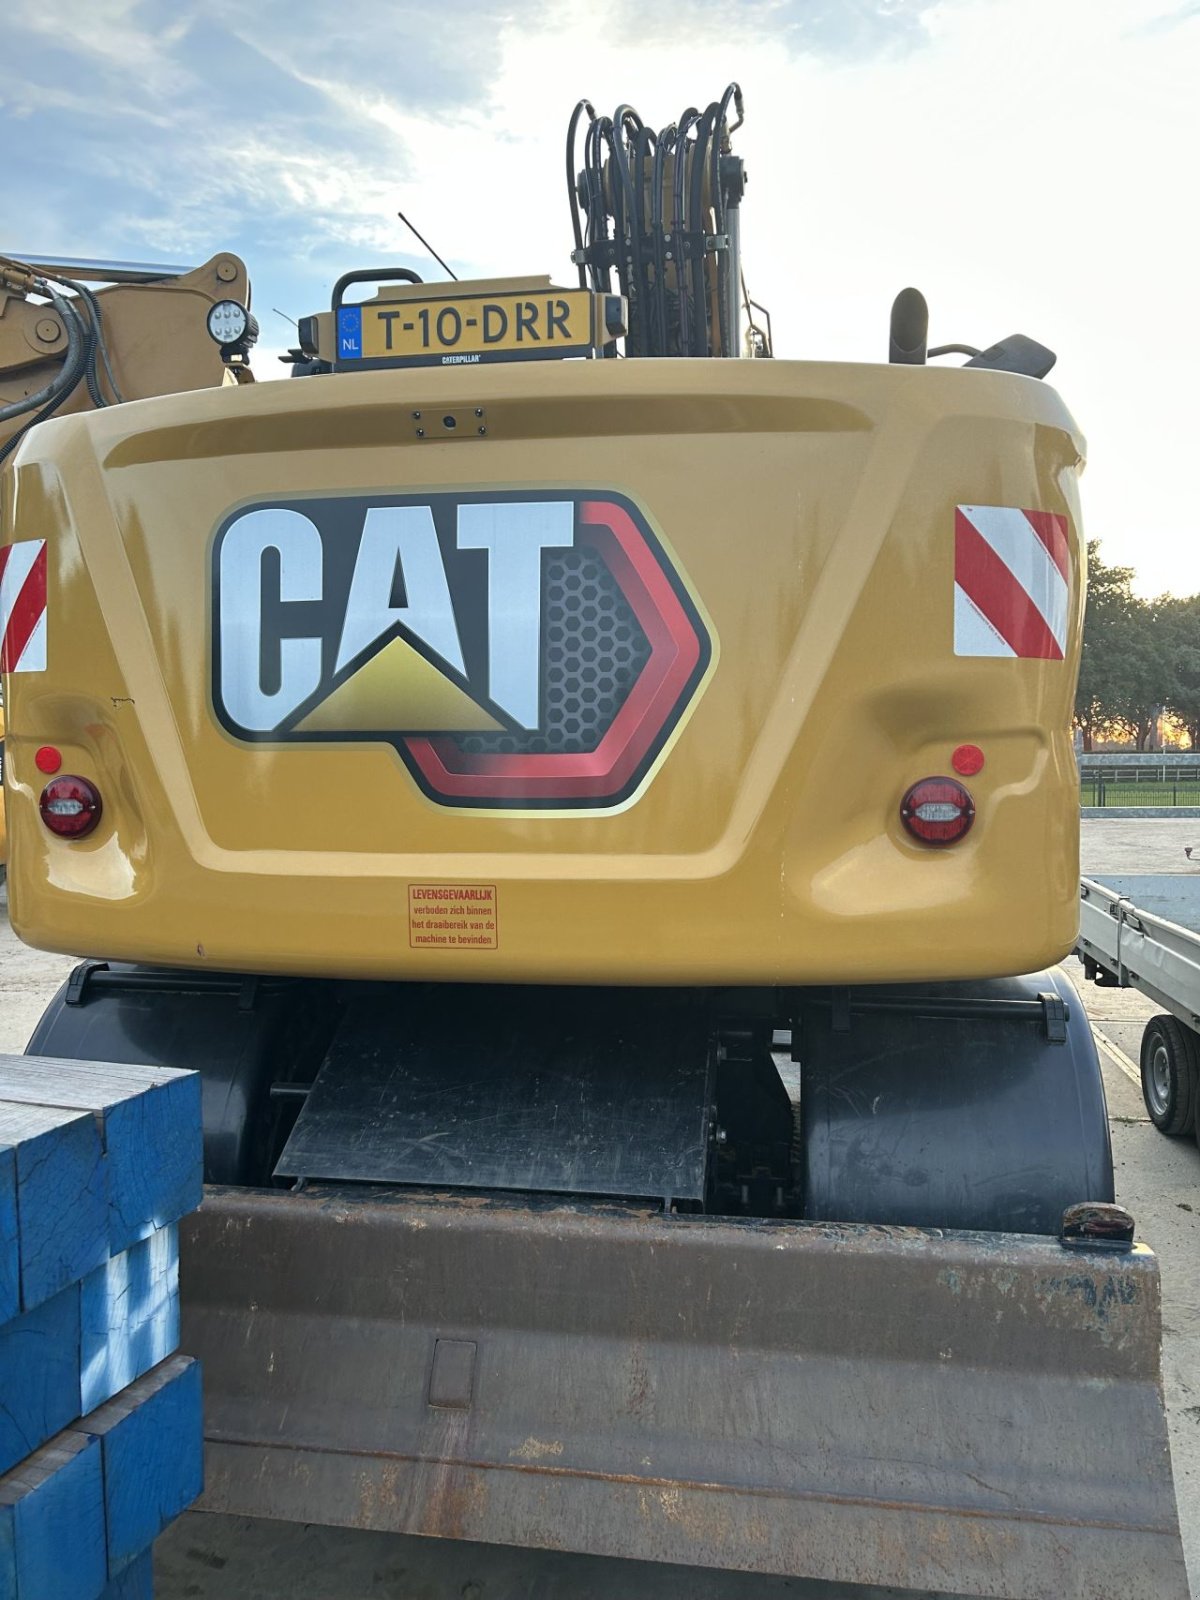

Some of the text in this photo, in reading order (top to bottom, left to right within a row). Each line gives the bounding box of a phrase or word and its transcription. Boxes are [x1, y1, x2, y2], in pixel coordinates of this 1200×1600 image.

[377, 300, 572, 350] T-10-DRR
[342, 338, 359, 350] NL
[220, 501, 574, 732] CAT
[412, 889, 493, 900] LEVENSGEVAARLIJK
[414, 905, 492, 916] verboden zich binnen
[412, 919, 494, 930] het draaibereik van de
[415, 934, 447, 944] machine
[457, 934, 492, 945] bevinden
